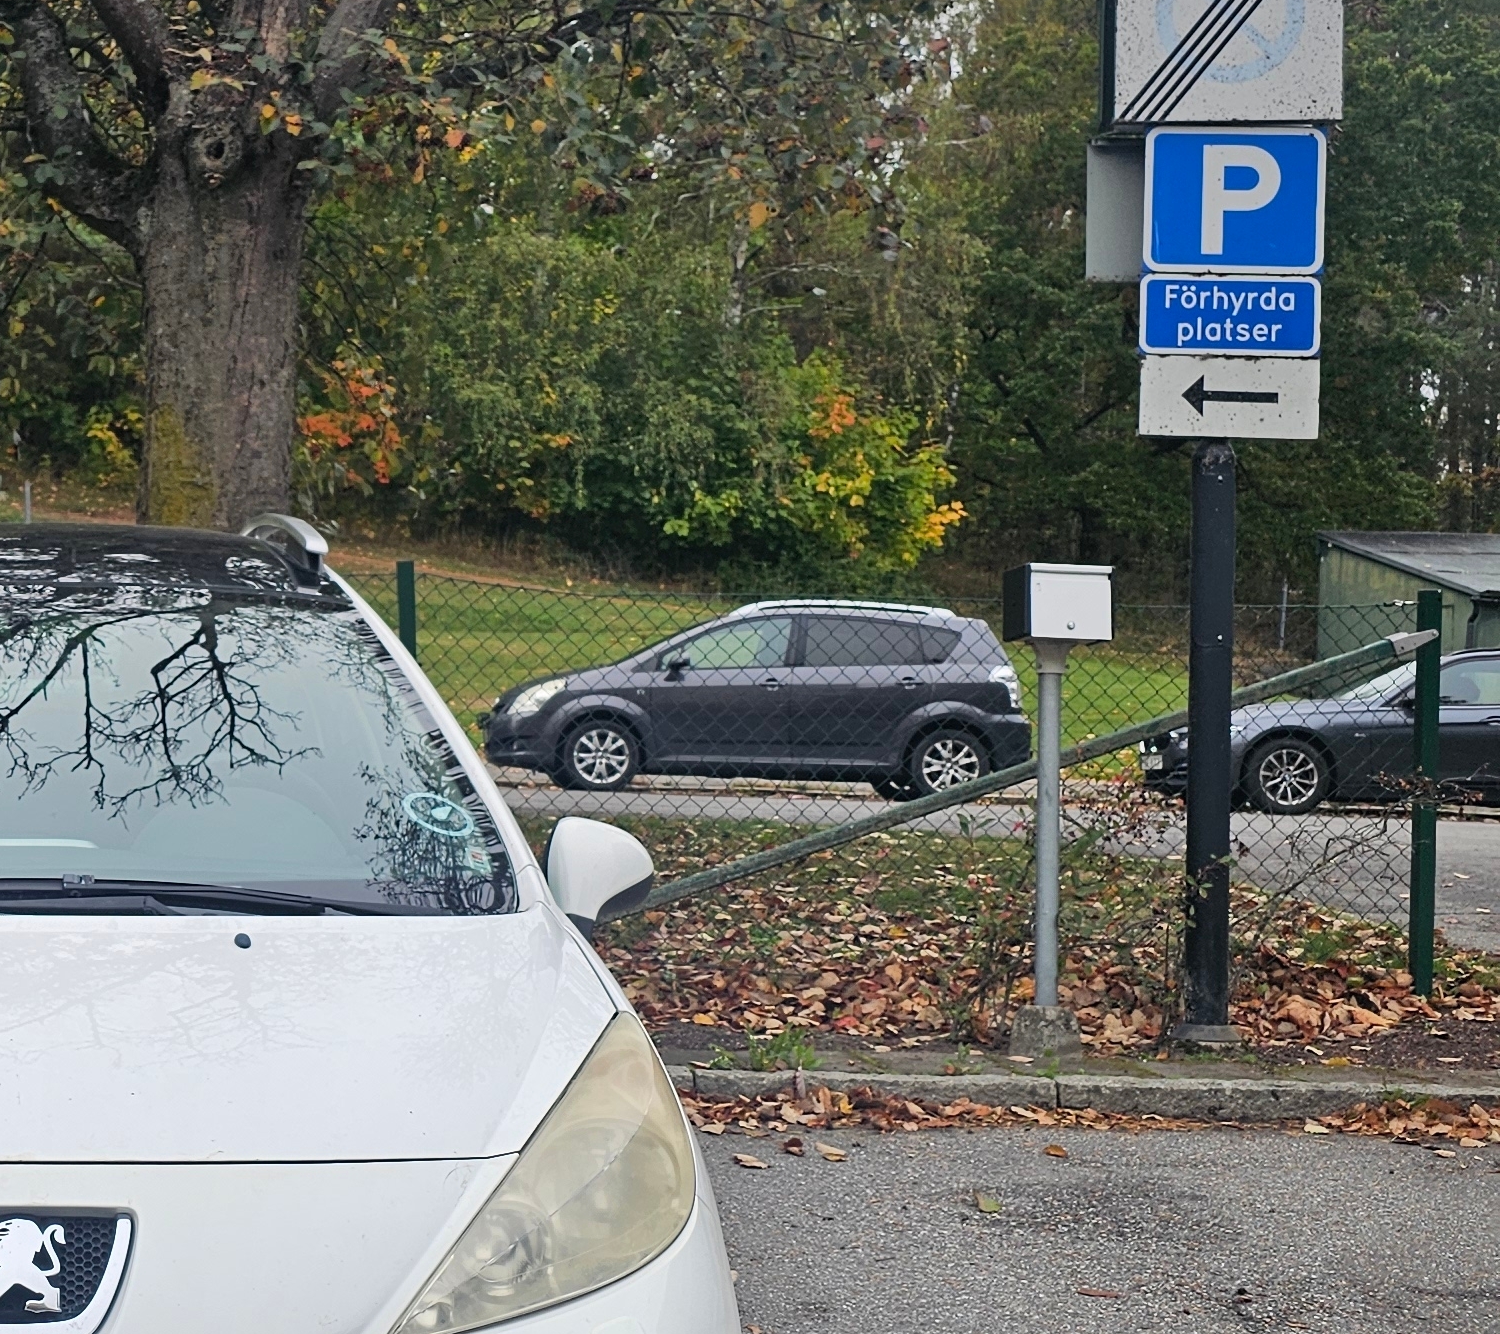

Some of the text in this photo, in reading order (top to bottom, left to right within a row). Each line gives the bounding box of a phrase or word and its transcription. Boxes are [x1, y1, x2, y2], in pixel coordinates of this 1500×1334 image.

[1200, 144, 1281, 255] P
[1164, 284, 1296, 316] Förhyrda
[1177, 317, 1283, 347] platser
